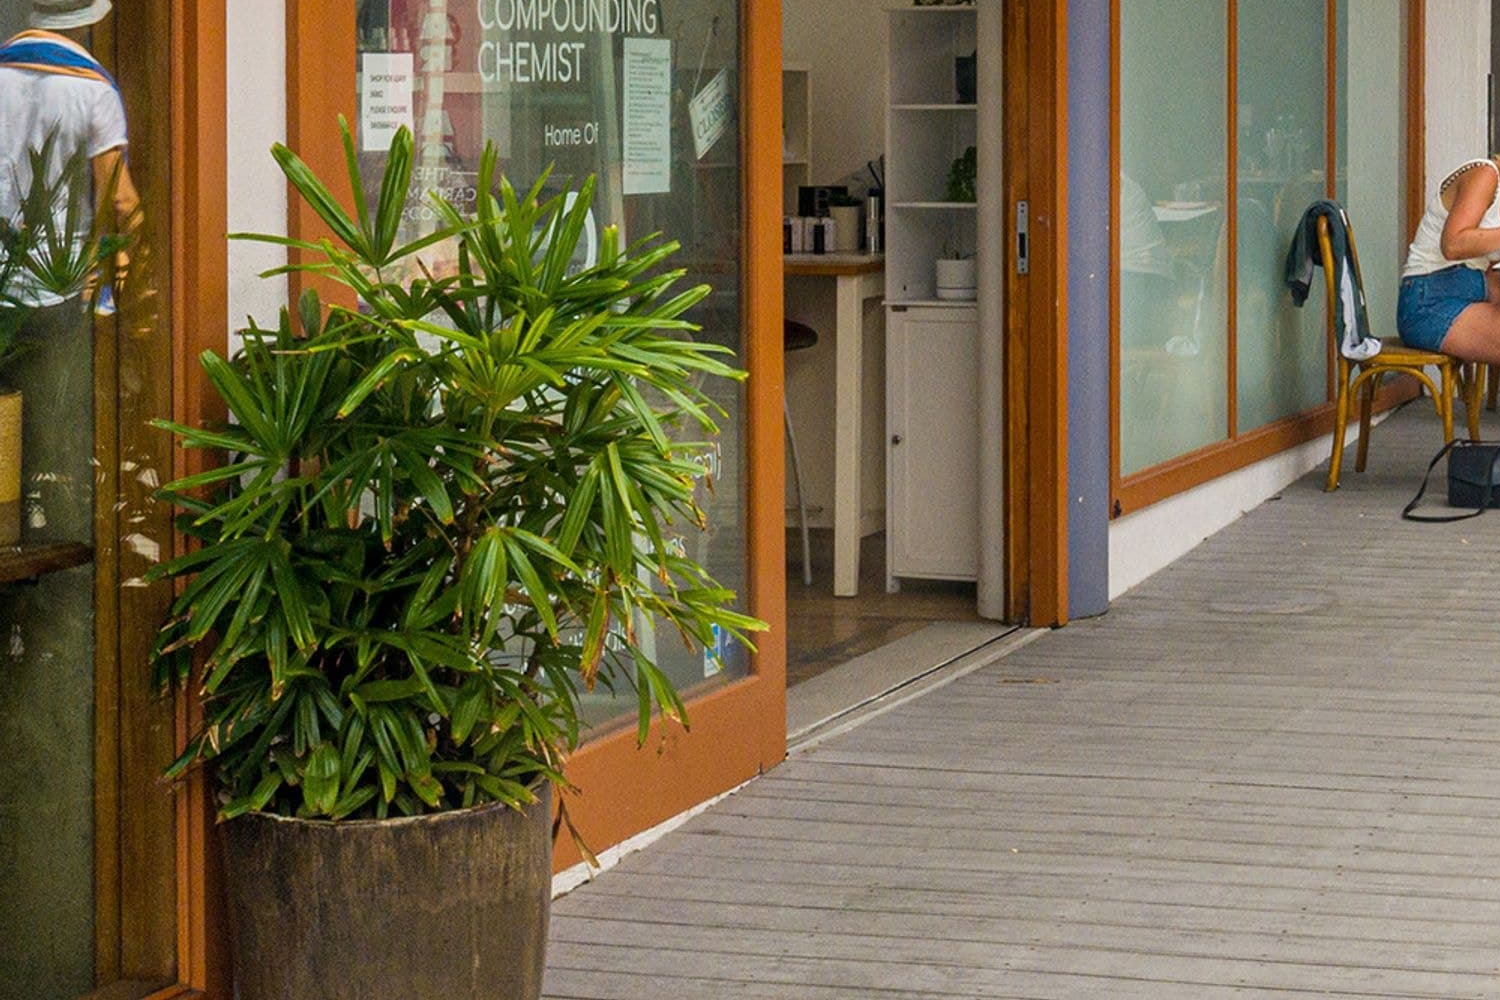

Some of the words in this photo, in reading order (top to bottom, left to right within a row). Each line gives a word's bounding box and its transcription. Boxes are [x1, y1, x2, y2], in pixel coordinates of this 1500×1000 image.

[477, 41, 585, 83] CHEMIST
[545, 124, 581, 147] Home
[583, 122, 599, 145] Of
